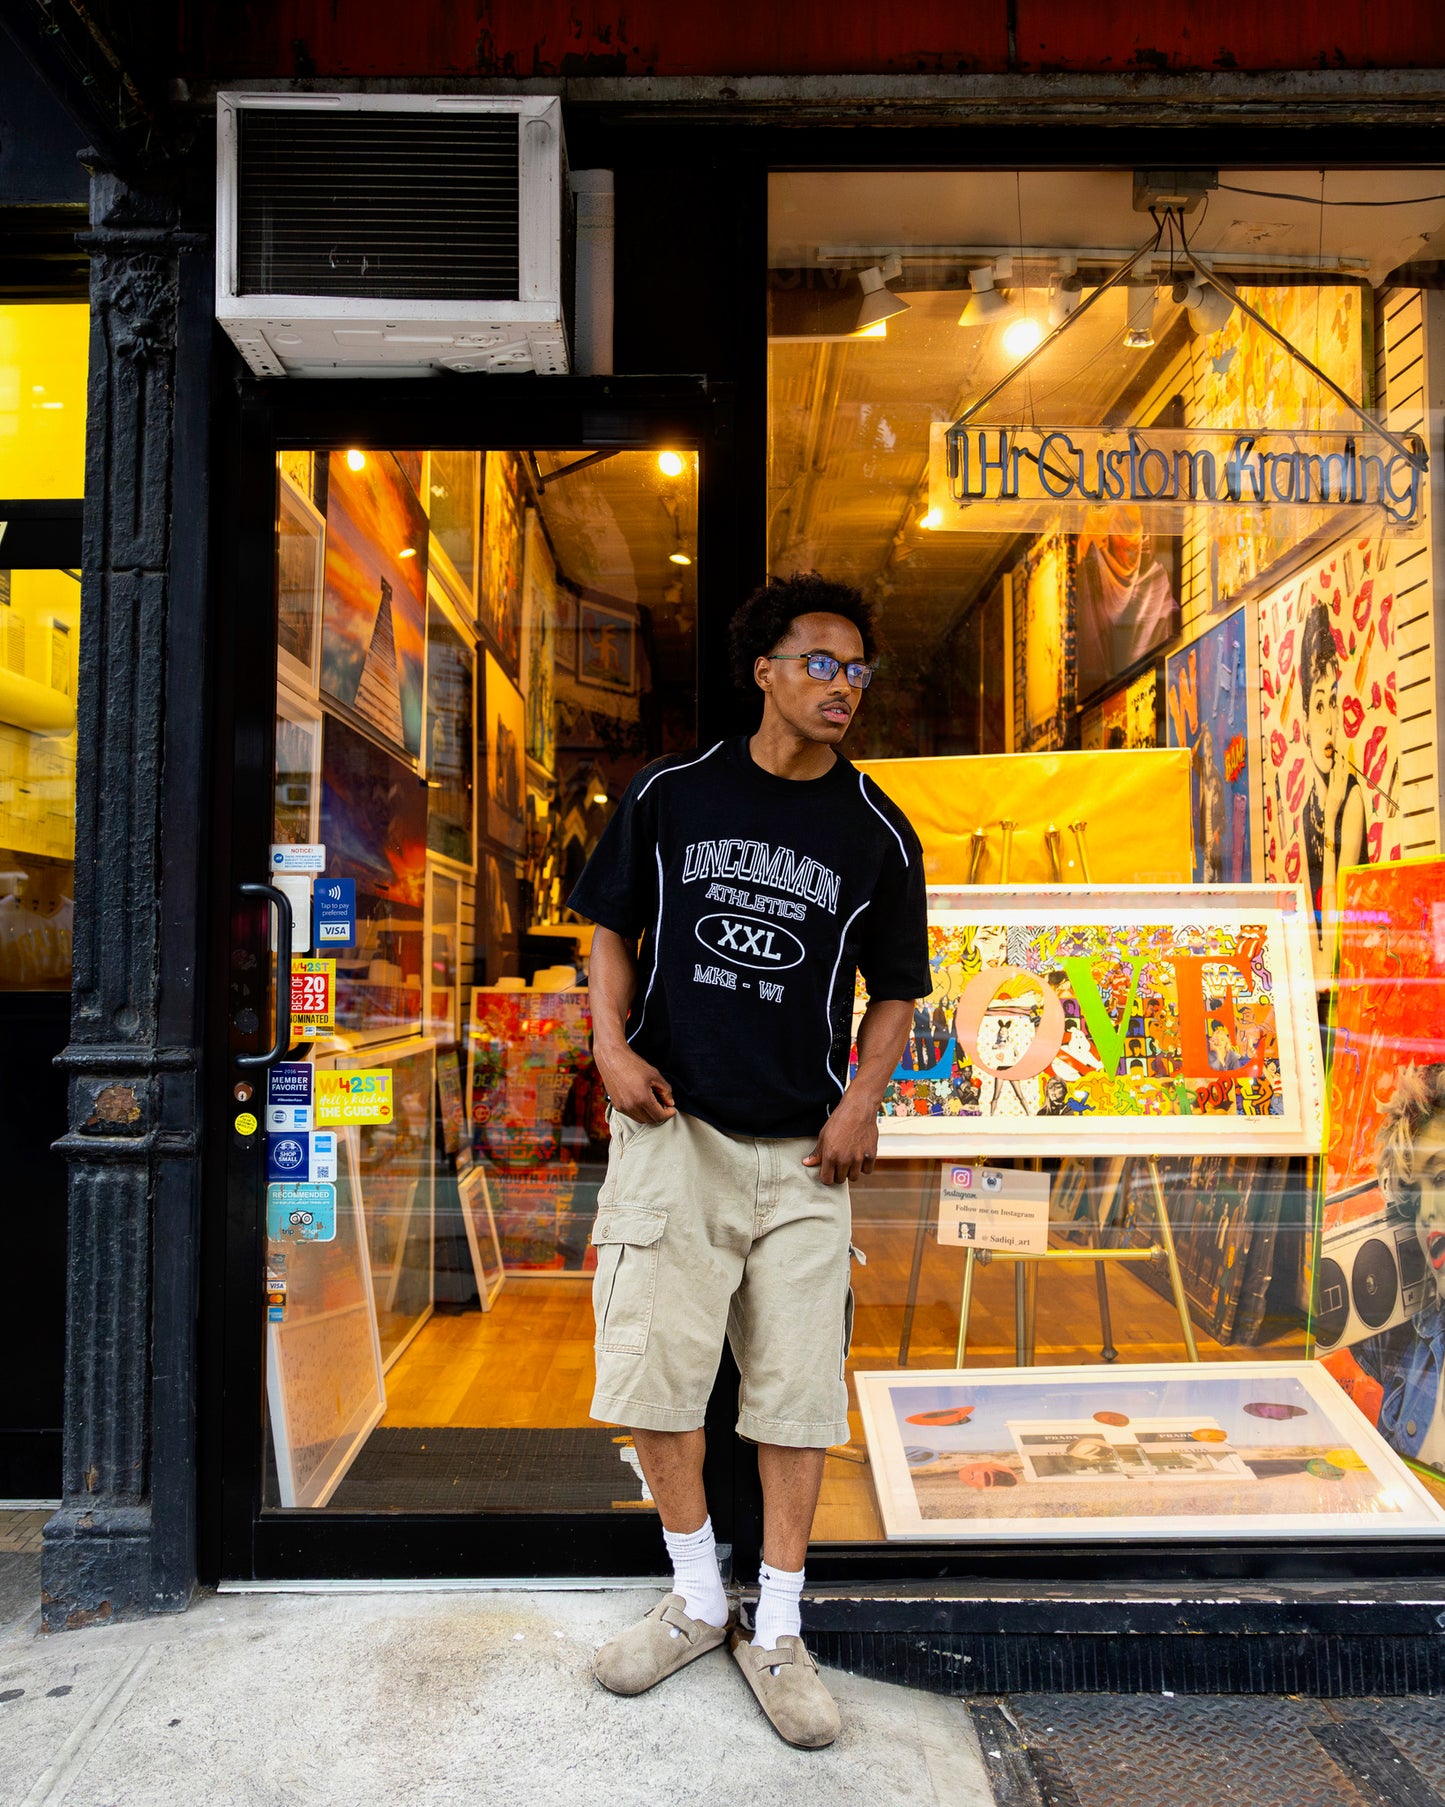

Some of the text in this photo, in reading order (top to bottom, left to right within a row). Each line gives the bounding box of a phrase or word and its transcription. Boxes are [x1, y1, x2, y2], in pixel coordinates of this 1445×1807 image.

[1038, 432, 1216, 499] Custom
[682, 838, 842, 915] UNCOMMON
[321, 902, 331, 910] Tap
[705, 882, 807, 922] ATHLETICS
[324, 926, 346, 935] VISA
[717, 919, 782, 961] XXL
[303, 976, 325, 993] 20
[693, 964, 737, 990] MKE
[759, 980, 784, 1003] WI
[291, 975, 303, 1011] BEST OF
[303, 993, 325, 1011] 23
[319, 1076, 390, 1093] W42ST
[1195, 1077, 1233, 1114] POP
[320, 1106, 340, 1118] THE
[344, 1105, 380, 1117] GUIDE
[943, 1189, 977, 1200] Instagram
[955, 1204, 977, 1213] Follow
[1000, 1209, 1035, 1219] Instagram
